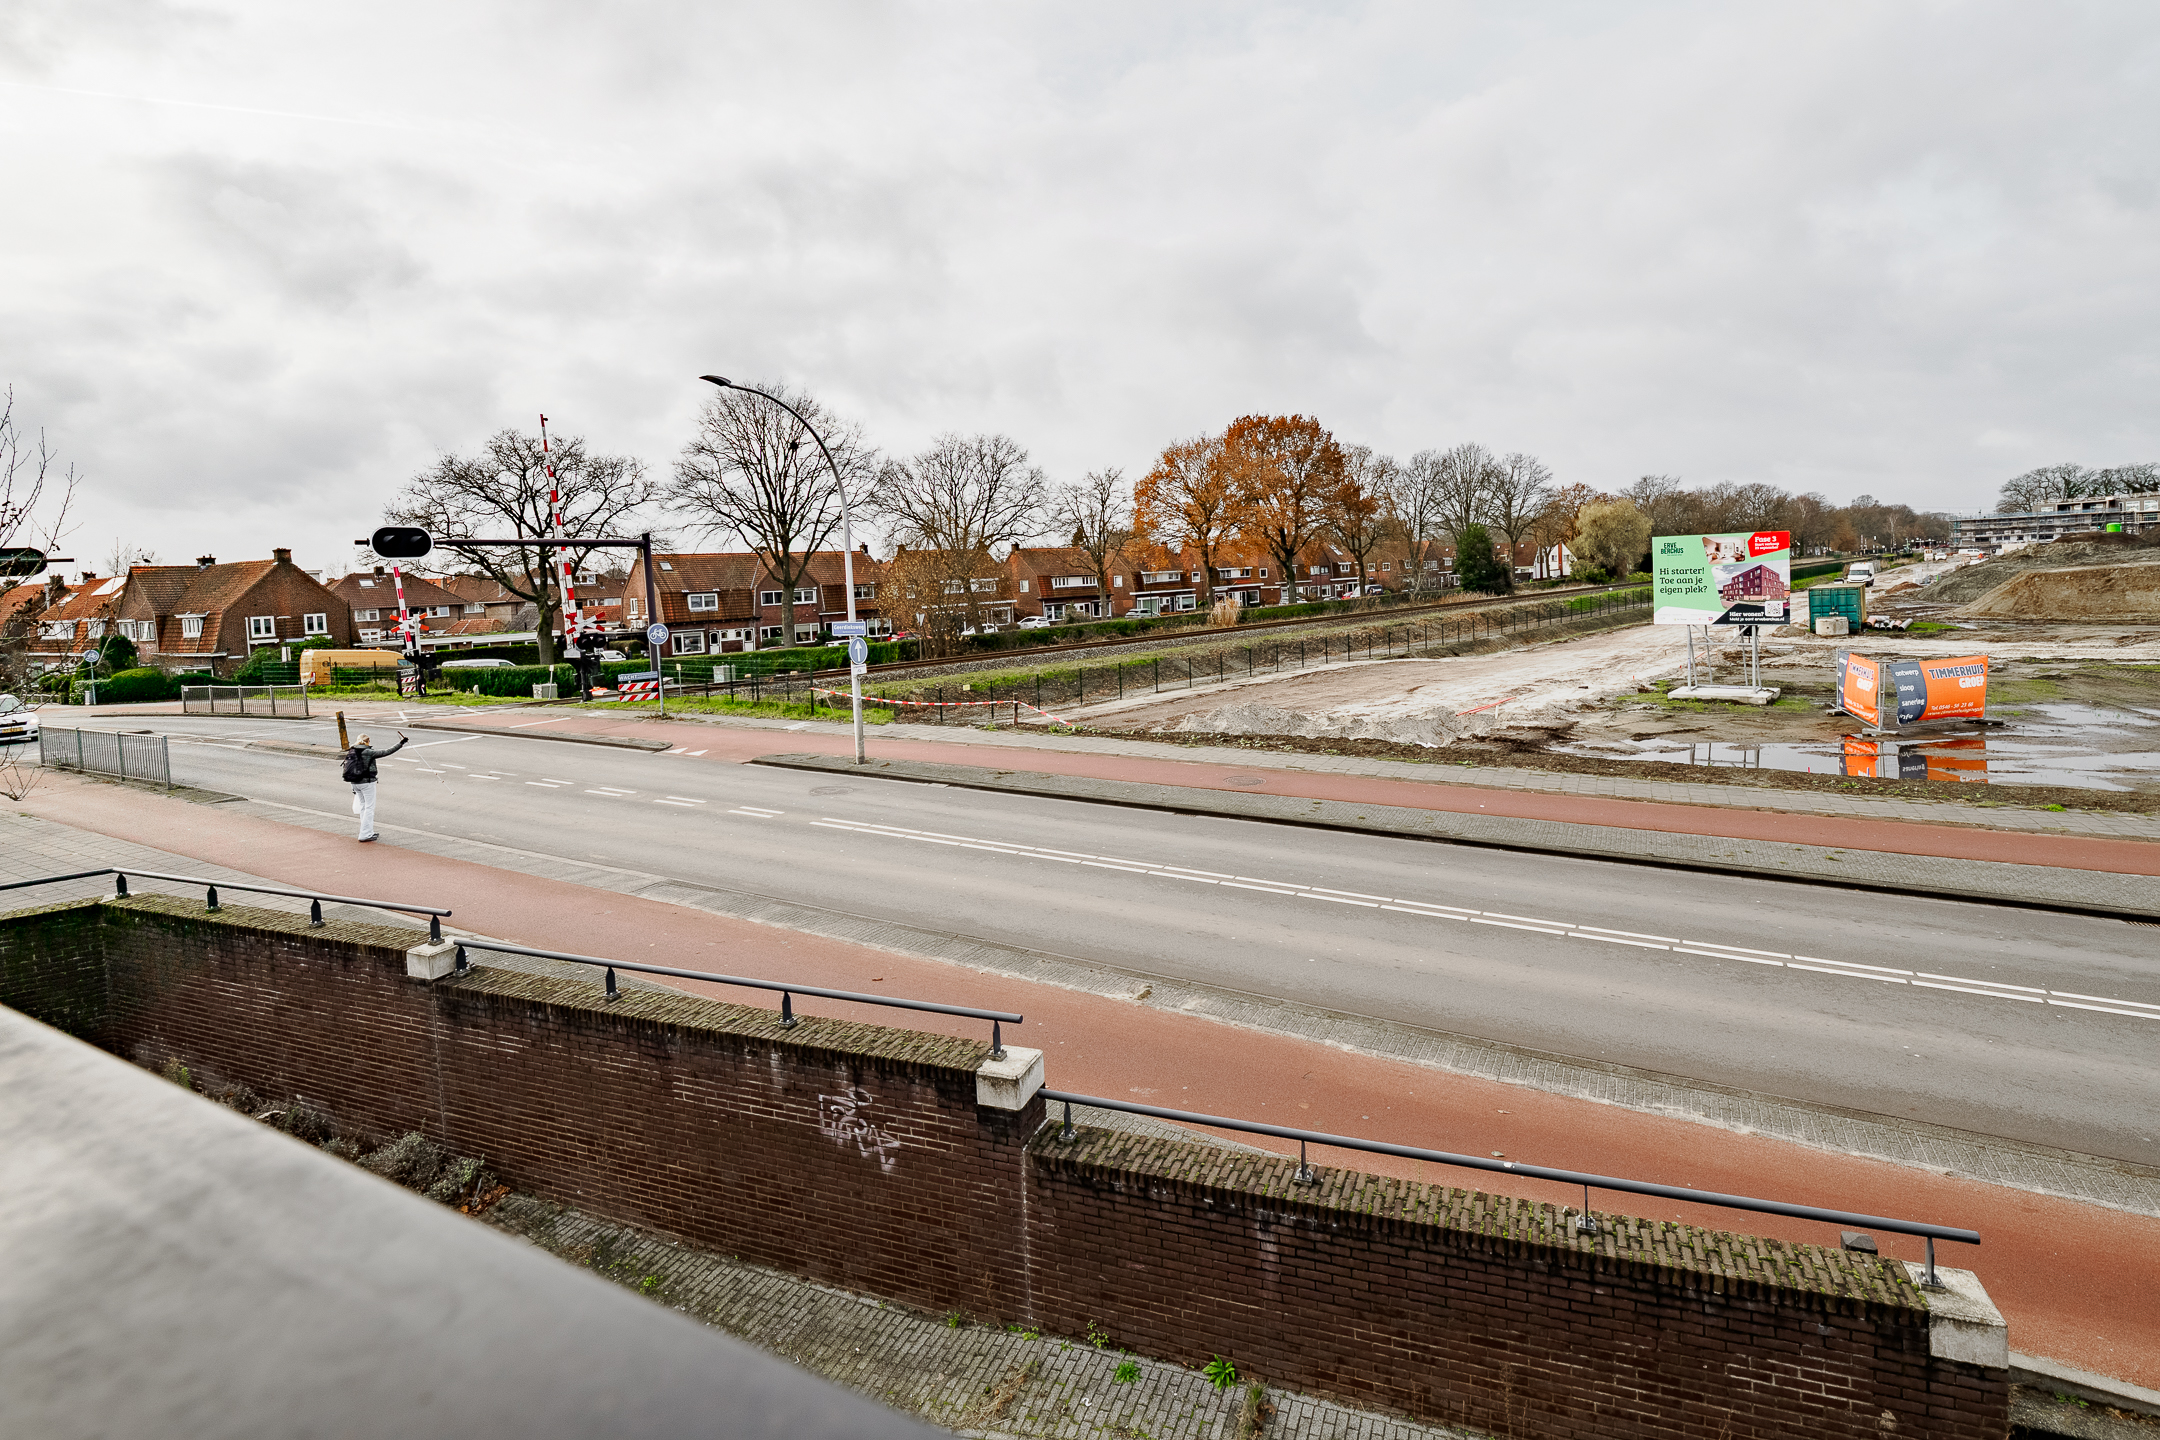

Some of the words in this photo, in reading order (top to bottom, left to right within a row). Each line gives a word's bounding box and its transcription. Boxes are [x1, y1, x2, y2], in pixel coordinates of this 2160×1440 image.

[1660, 547, 1684, 555] BERCHUS
[1659, 567, 1669, 575] Hi
[1671, 566, 1705, 575] starter!
[1694, 576, 1703, 585] je
[1659, 586, 1683, 595] eigen
[1684, 585, 1708, 595] plek?
[1894, 669, 1920, 677] ontwerp
[1928, 663, 1985, 680] TIMMERHUIS
[1958, 675, 1985, 688] GROEP
[1899, 684, 1915, 692] sloop
[1901, 698, 1925, 707] sanering
